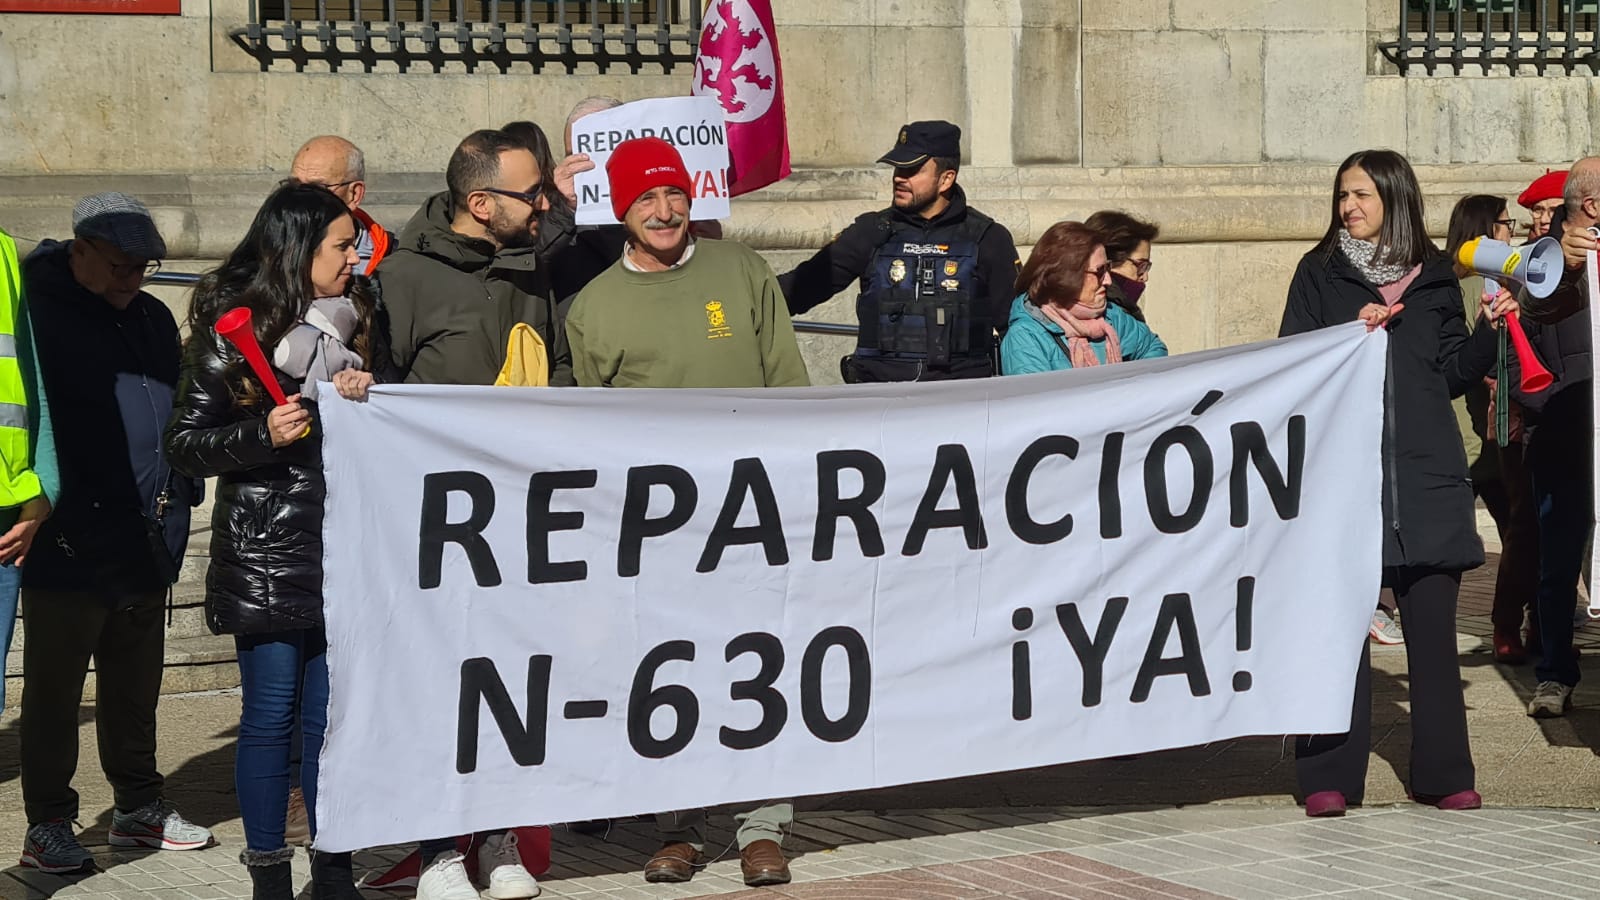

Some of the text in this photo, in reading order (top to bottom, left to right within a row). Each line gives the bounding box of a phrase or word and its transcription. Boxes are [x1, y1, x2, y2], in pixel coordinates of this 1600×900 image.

[903, 247, 948, 255] NACIONAL
[418, 390, 1306, 590] REPARACIÓN
[456, 575, 1256, 775] N-630 ¡YA!
